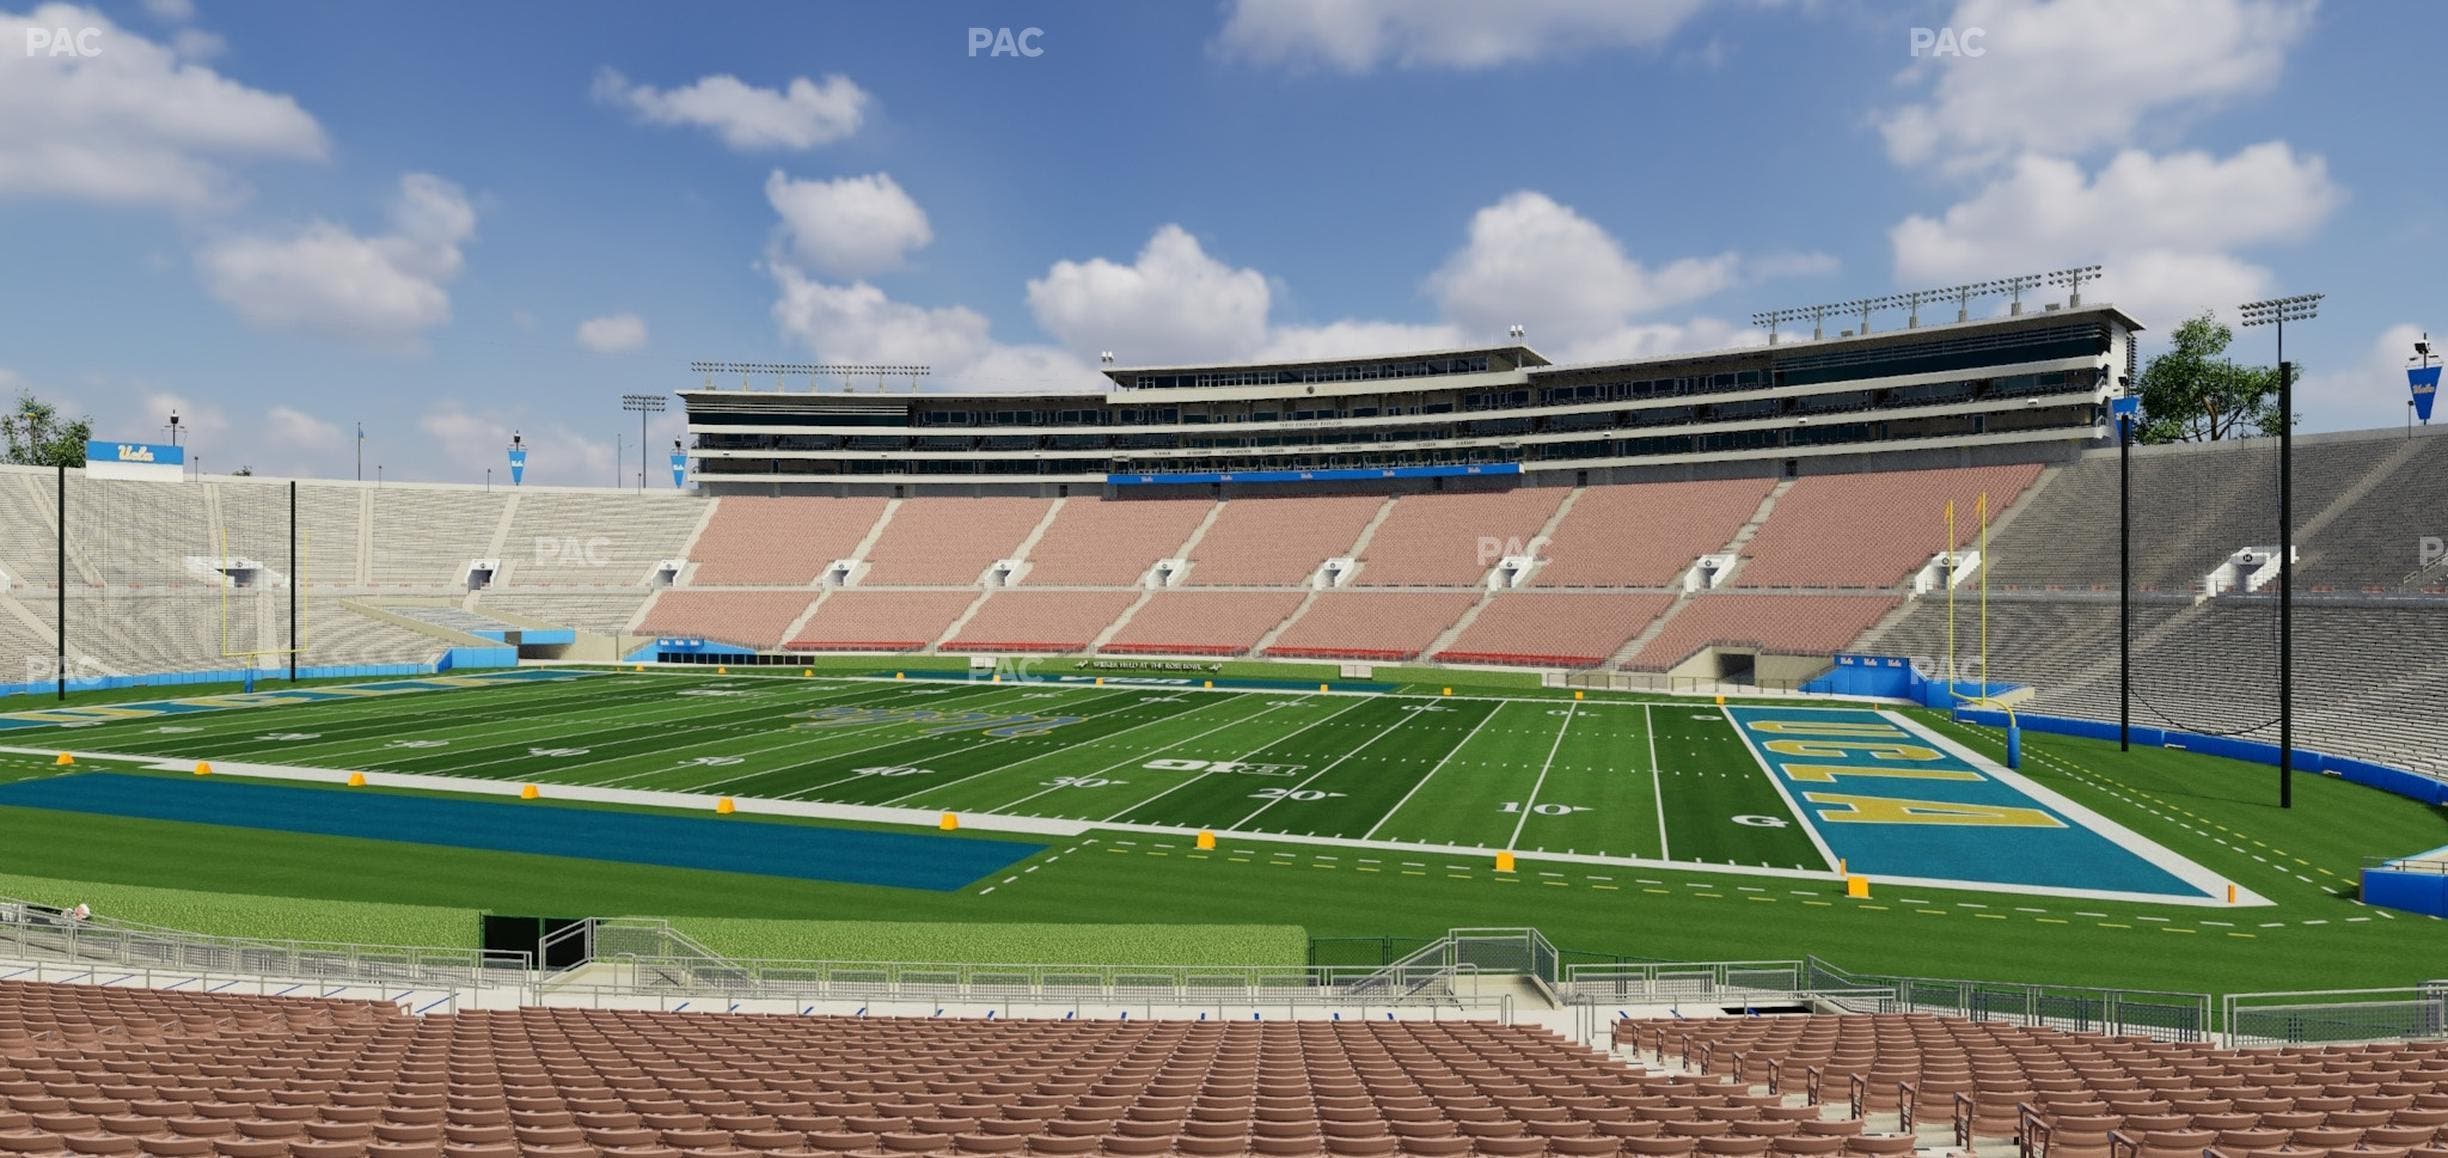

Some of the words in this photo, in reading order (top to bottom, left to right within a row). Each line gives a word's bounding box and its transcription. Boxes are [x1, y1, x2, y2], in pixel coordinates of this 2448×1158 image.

[1746, 720, 2070, 828] UCLA
[1247, 788, 1327, 801] 20
[1496, 801, 1573, 816] 10
[1731, 815, 1790, 828] G
